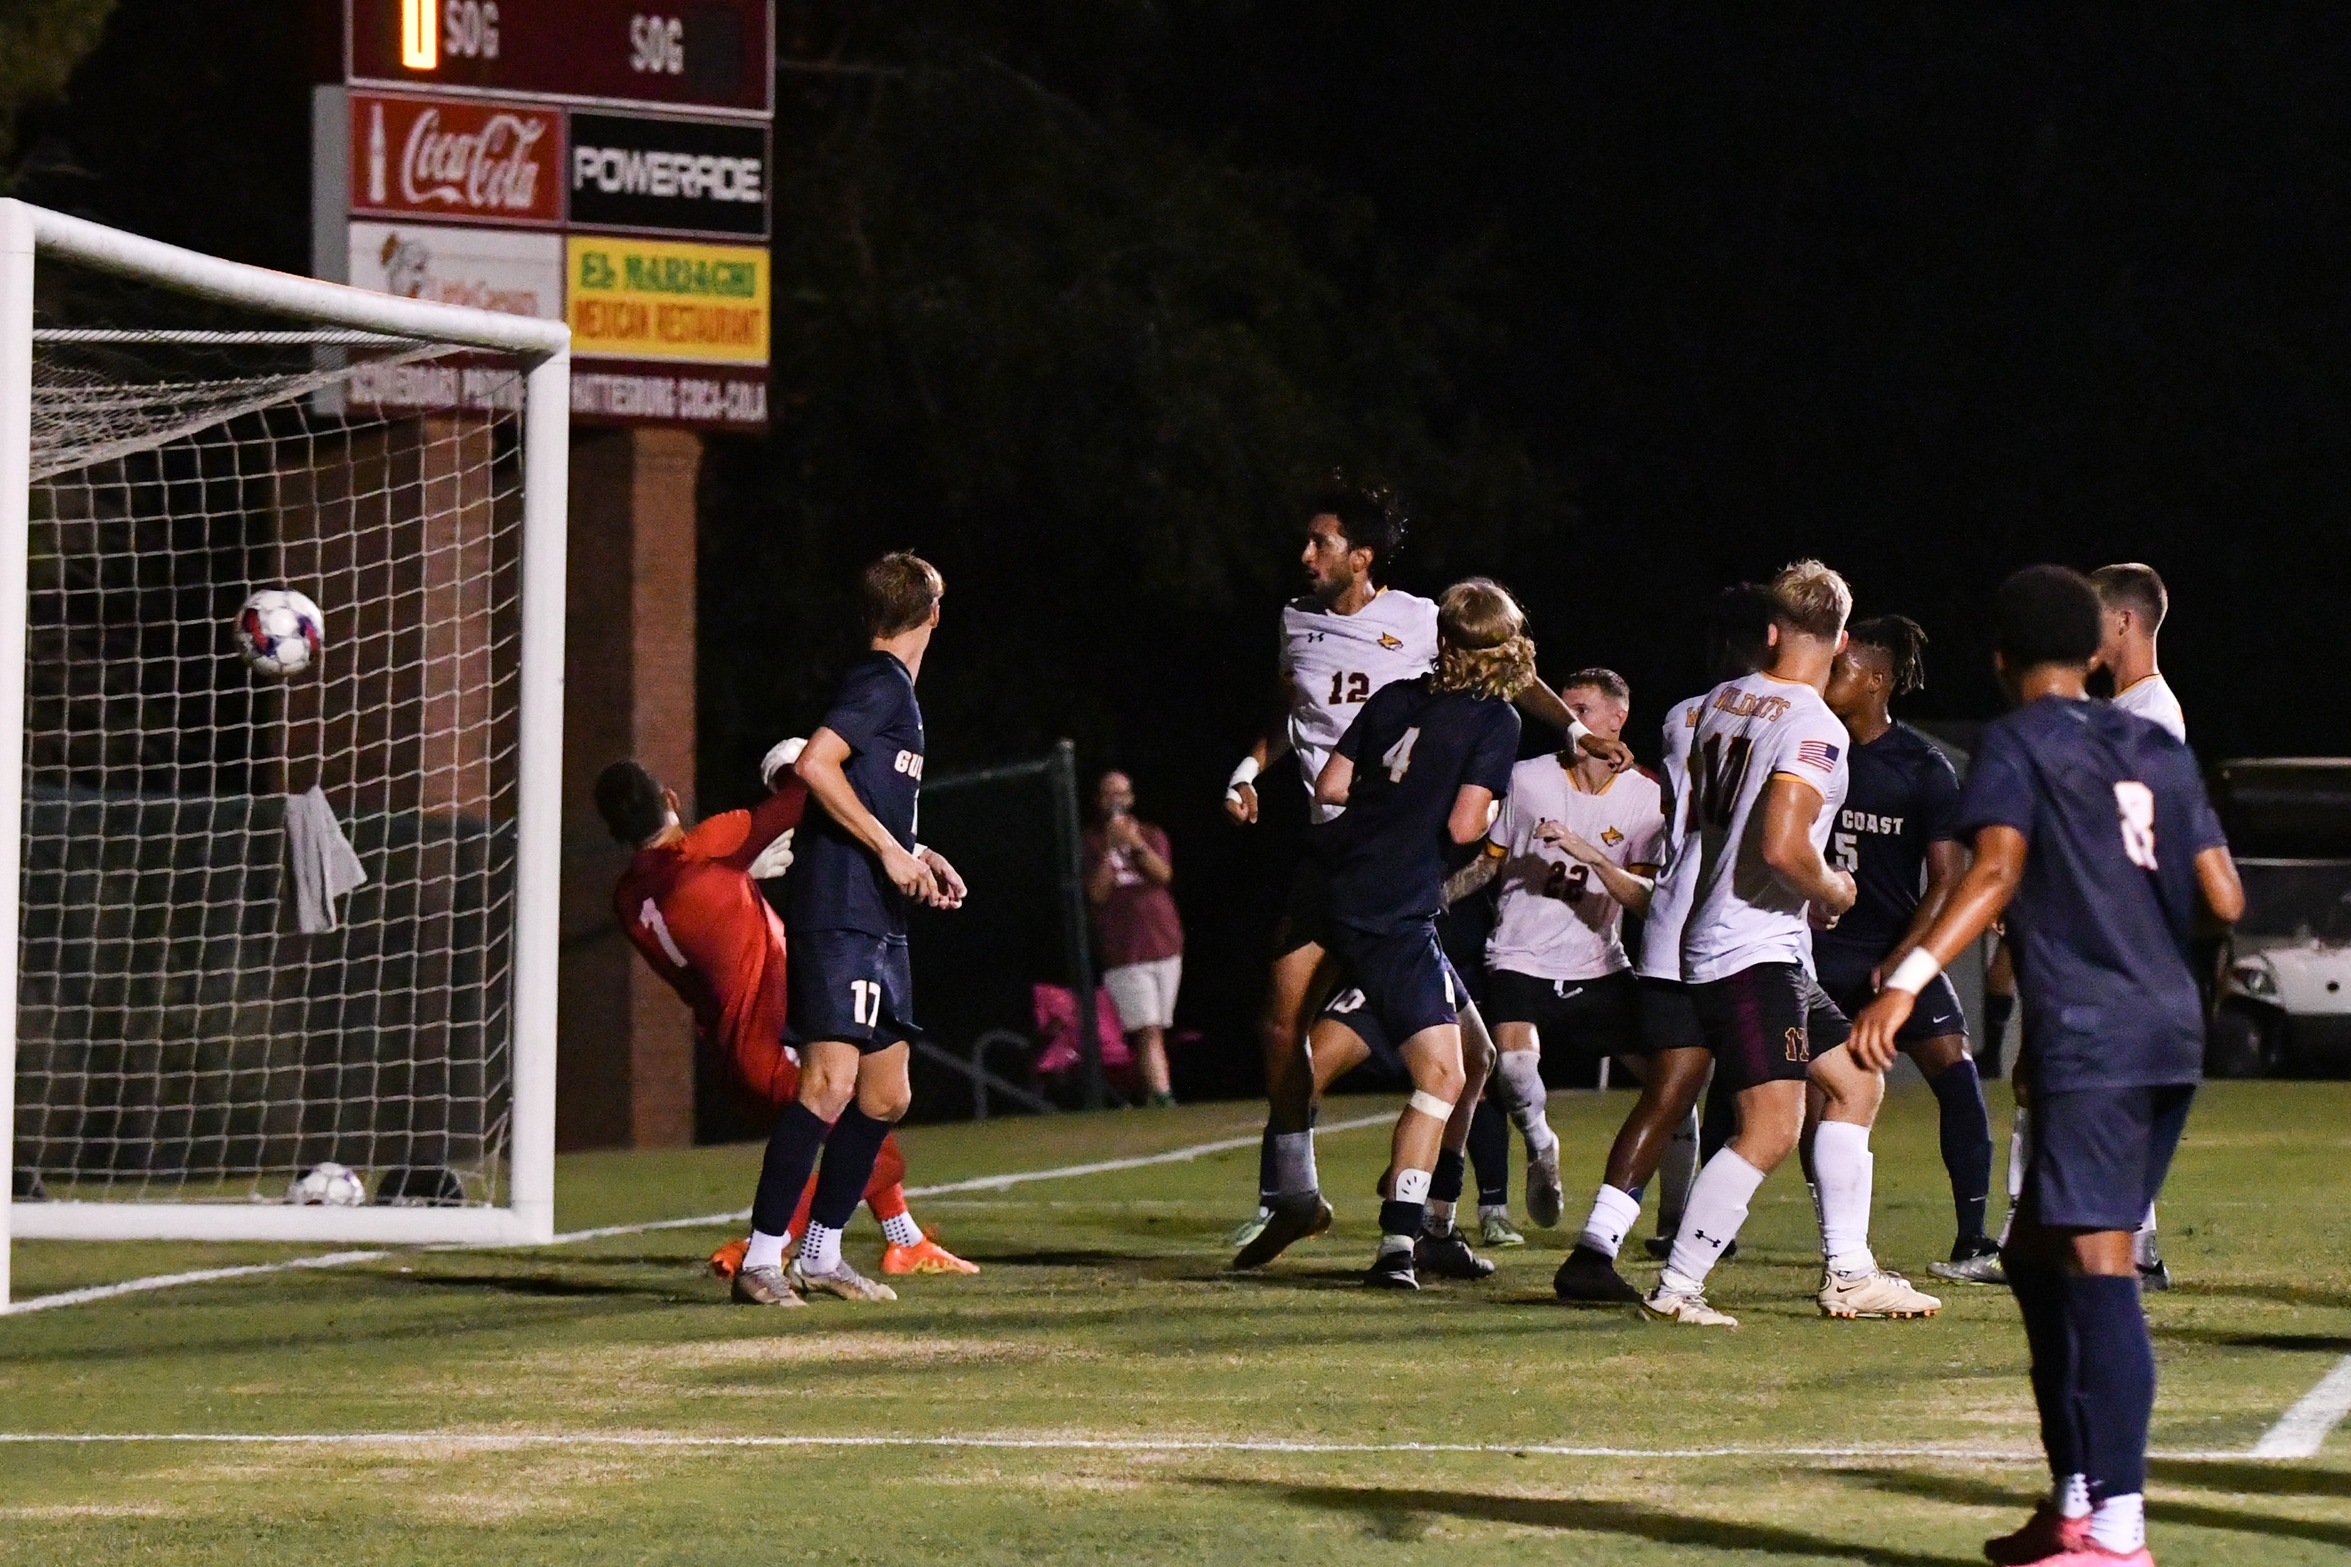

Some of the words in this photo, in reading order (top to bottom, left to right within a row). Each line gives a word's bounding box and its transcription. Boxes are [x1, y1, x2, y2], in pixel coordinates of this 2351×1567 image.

[445, 1, 500, 58] SOG
[629, 15, 684, 74] SOG
[573, 145, 763, 202] POWERADE
[1328, 670, 1371, 705] 12
[1382, 726, 1421, 783] 4
[1842, 809, 1904, 835] COAST
[2113, 780, 2158, 871] 8
[1835, 832, 1858, 873] 5
[638, 896, 689, 968] 1
[851, 979, 881, 1028] 17
